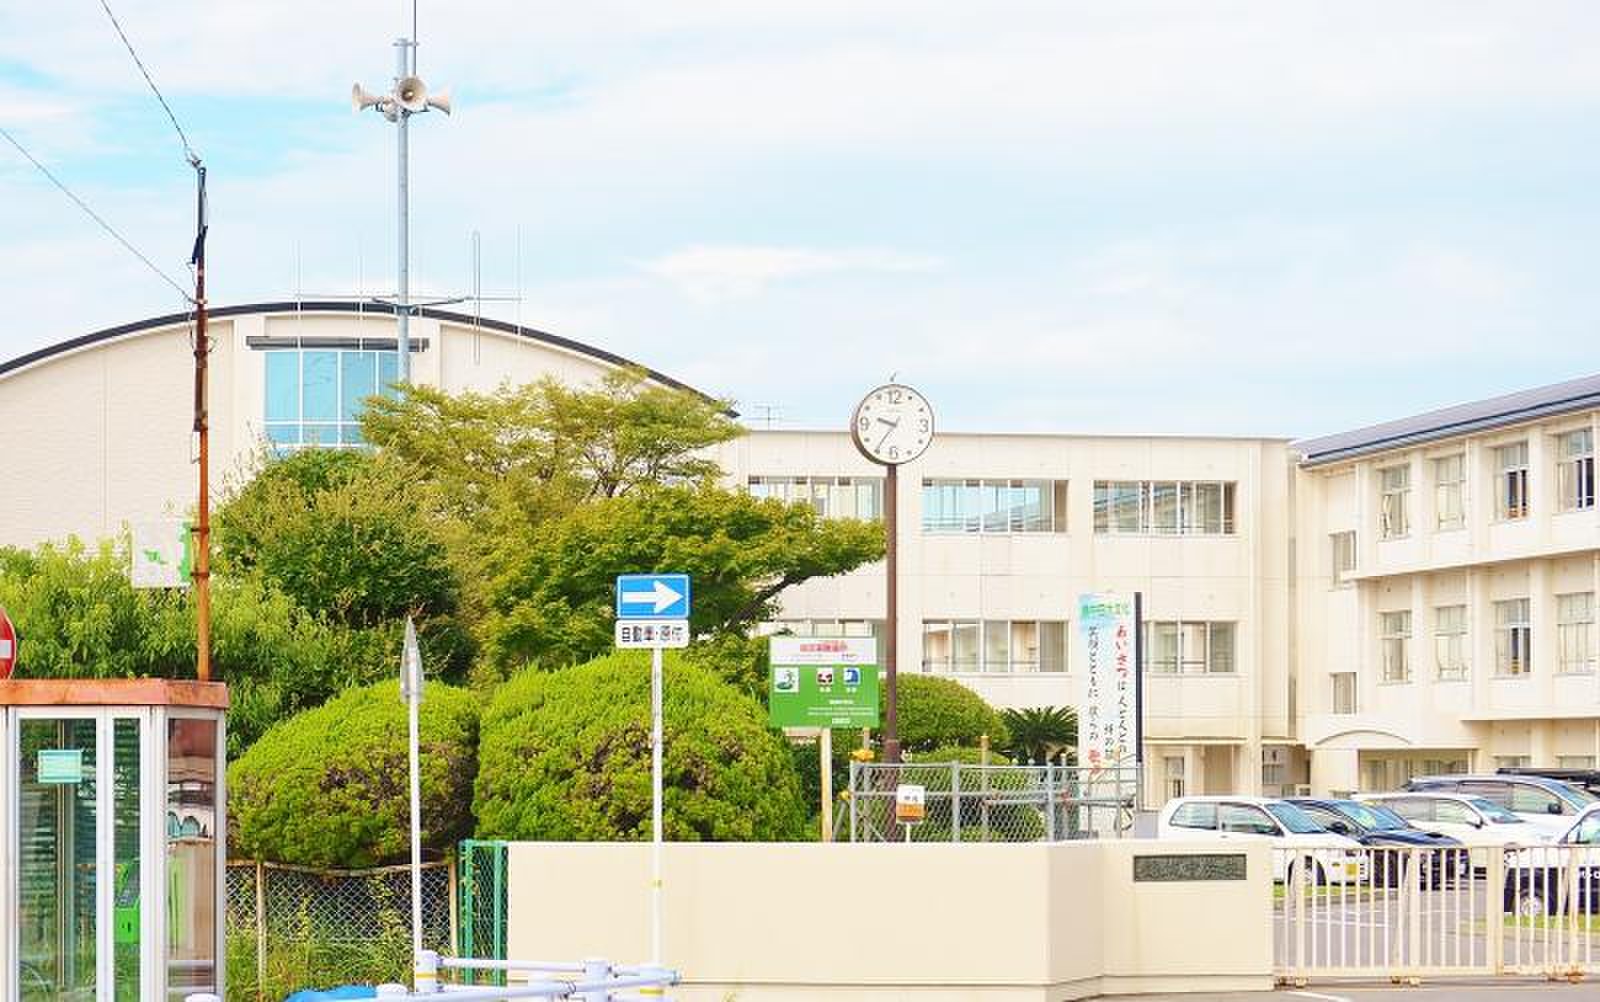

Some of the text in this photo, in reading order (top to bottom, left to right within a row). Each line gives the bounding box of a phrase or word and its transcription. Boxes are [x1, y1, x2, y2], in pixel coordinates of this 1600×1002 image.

[887, 390, 904, 404] 12
[859, 417, 870, 431] 9
[919, 418, 929, 432] 3
[888, 446, 899, 460] 6
